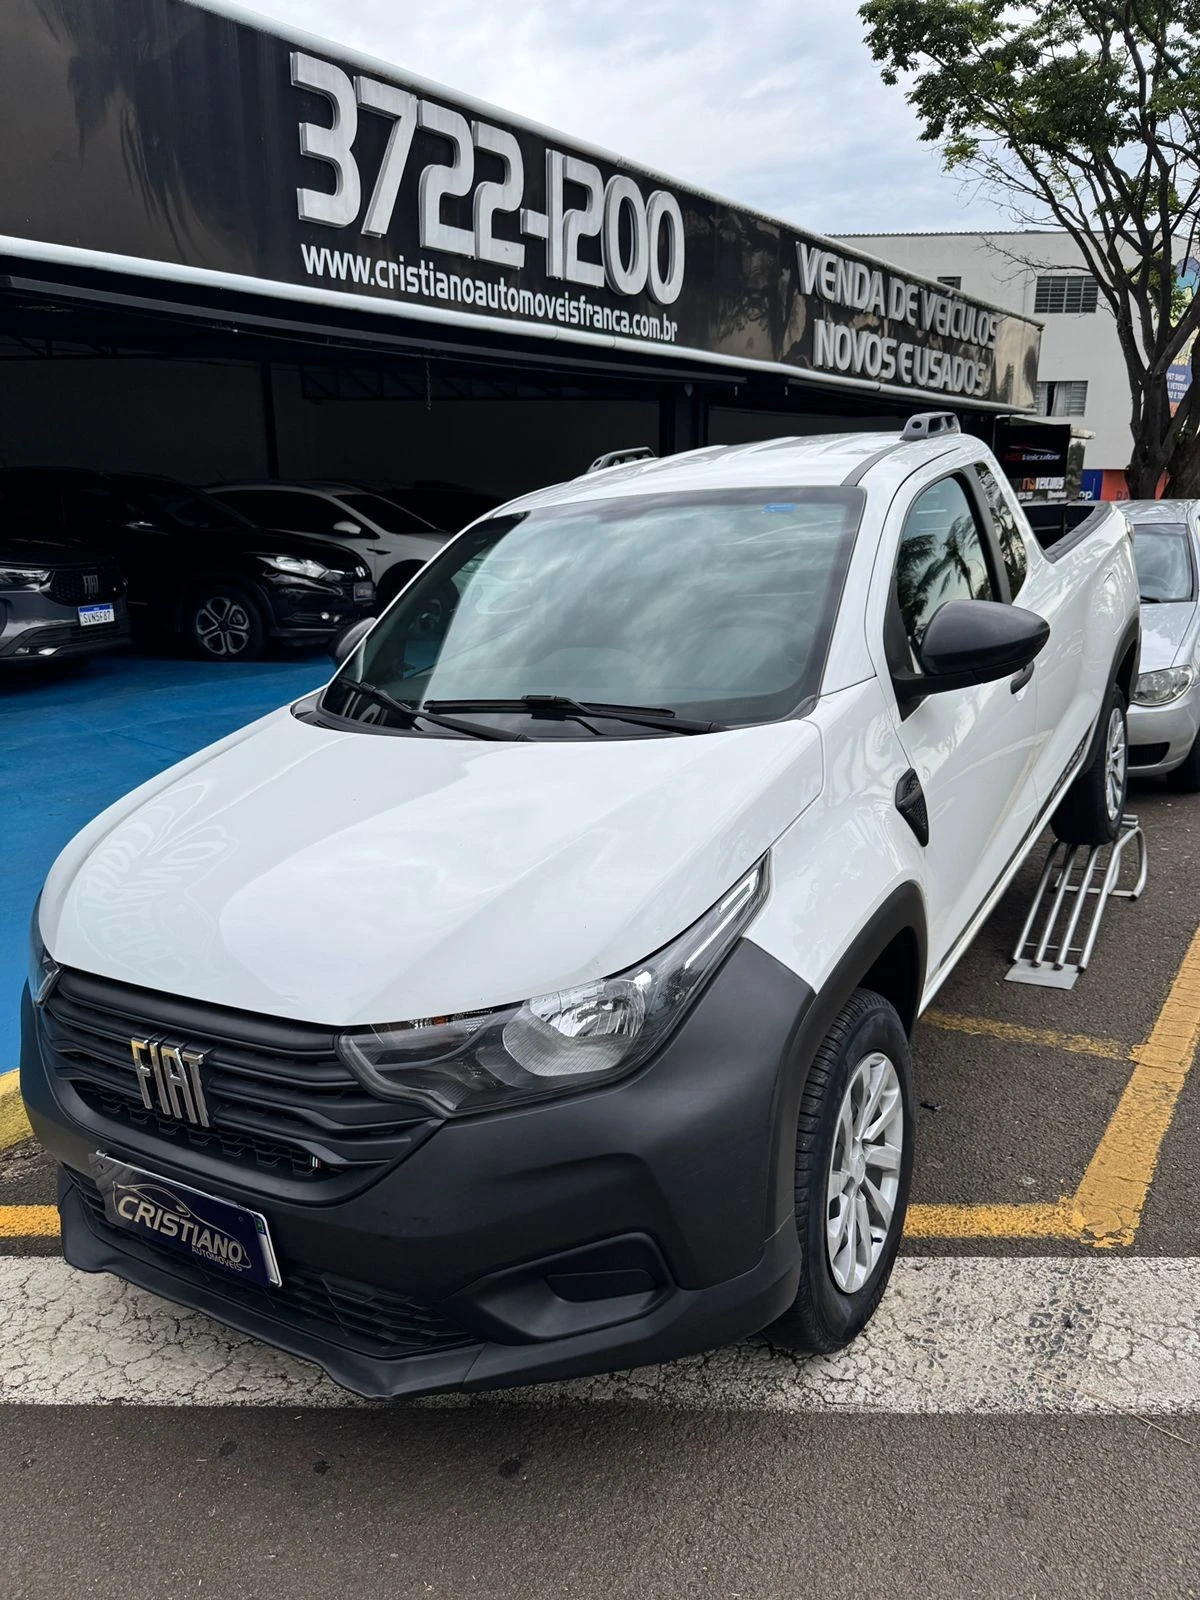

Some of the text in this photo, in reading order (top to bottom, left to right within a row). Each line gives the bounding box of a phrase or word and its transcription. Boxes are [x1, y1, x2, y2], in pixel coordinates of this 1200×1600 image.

[290, 52, 685, 305] 3722-1200
[301, 243, 678, 342] www.cristianoautomoveisfranca.com.br
[796, 241, 885, 317] VENDA
[887, 276, 919, 326] DE
[813, 319, 989, 396] NOVOS E USADOS
[131, 1038, 210, 1128] FIAT
[118, 1195, 243, 1263] CRISTIANO
